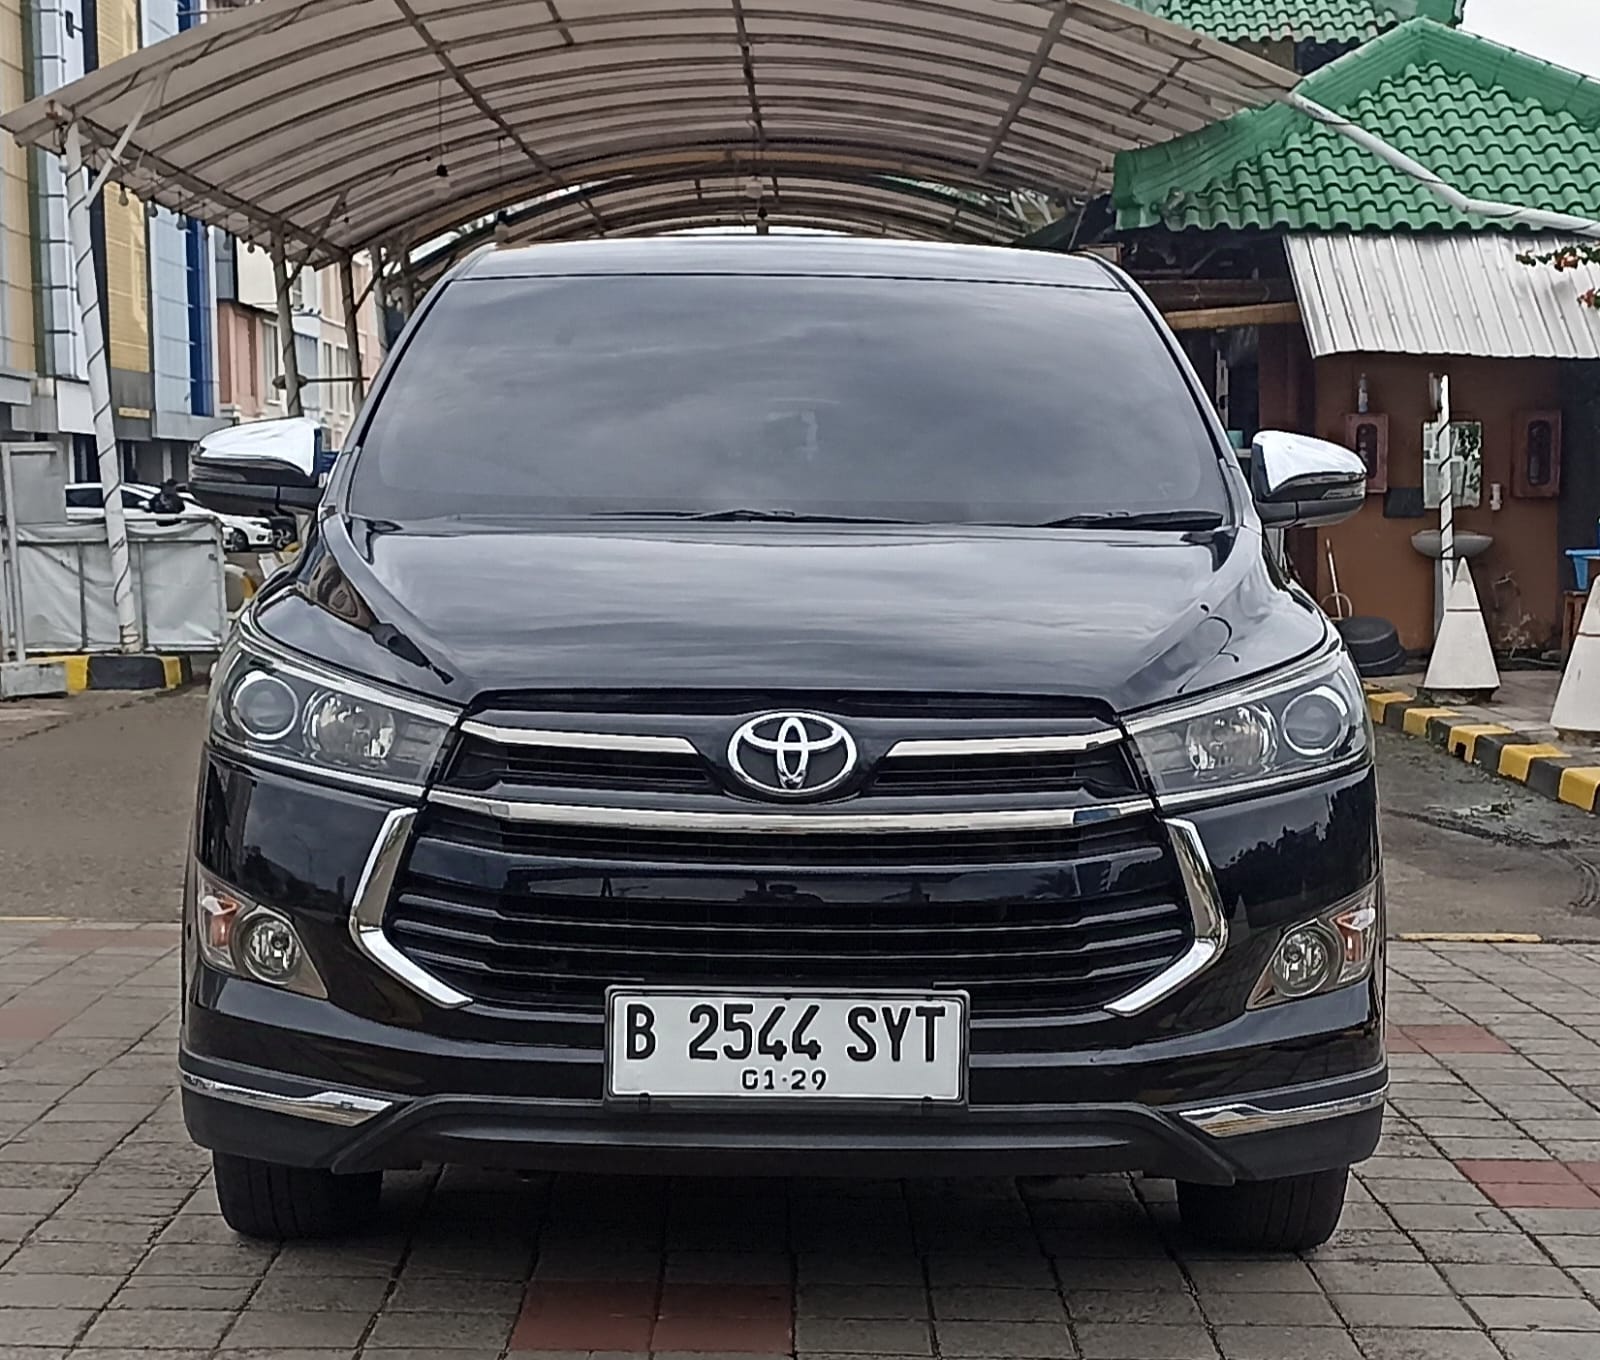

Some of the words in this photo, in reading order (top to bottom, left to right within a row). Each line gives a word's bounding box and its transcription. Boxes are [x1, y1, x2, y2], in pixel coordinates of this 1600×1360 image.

[626, 1004, 656, 1060] B
[688, 1004, 822, 1061] 2544
[846, 1005, 946, 1062] SYT
